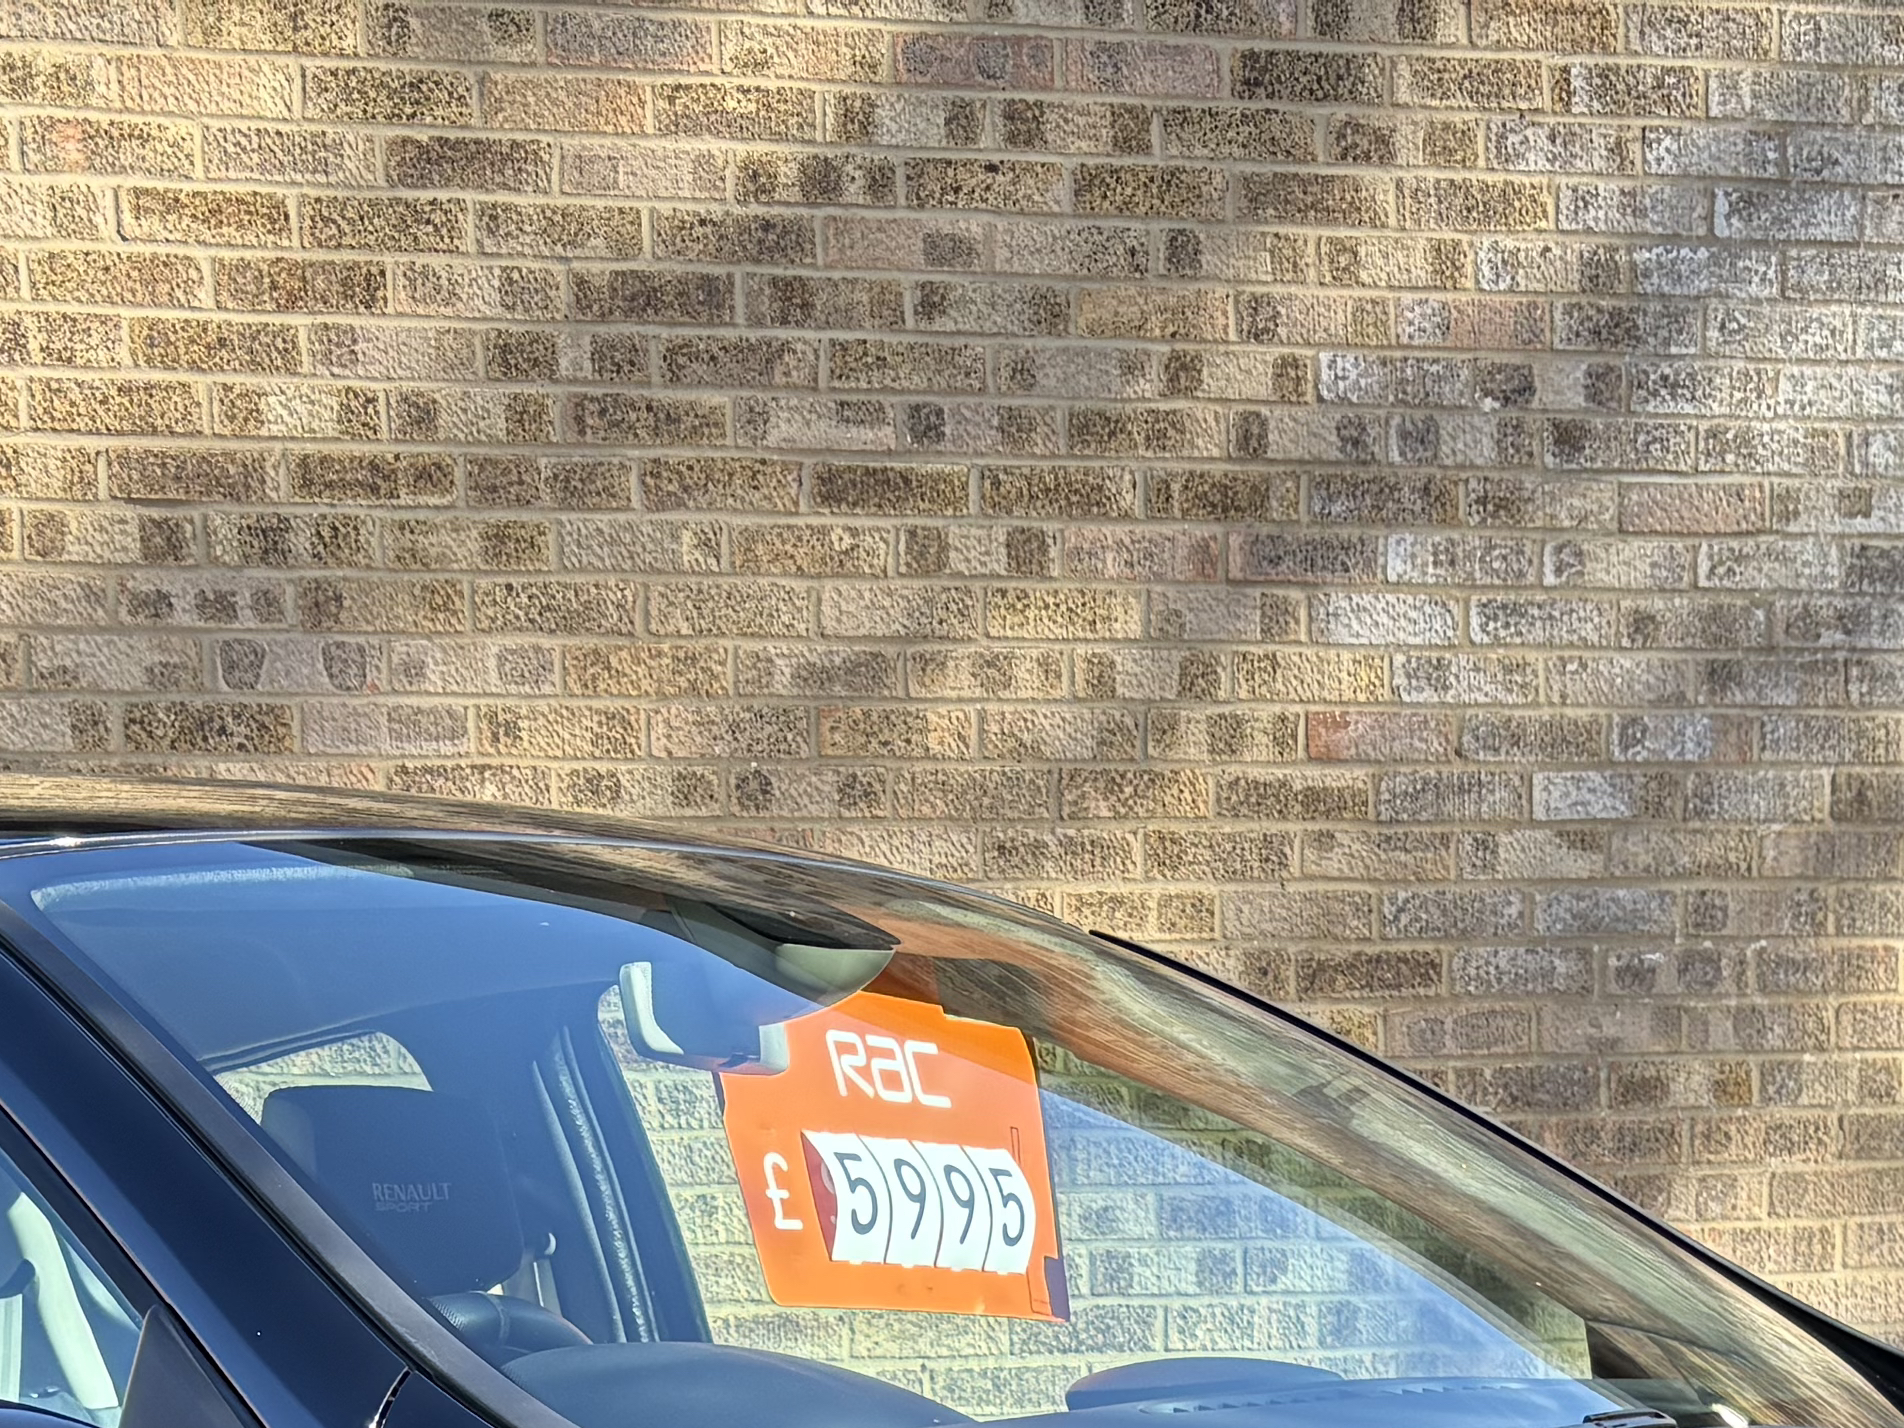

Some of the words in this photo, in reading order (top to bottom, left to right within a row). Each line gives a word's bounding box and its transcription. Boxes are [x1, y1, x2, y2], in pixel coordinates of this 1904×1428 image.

[372, 1182, 452, 1202] RENAULT
[834, 1151, 1026, 1247] 5995
[375, 1201, 433, 1213] SPORT
